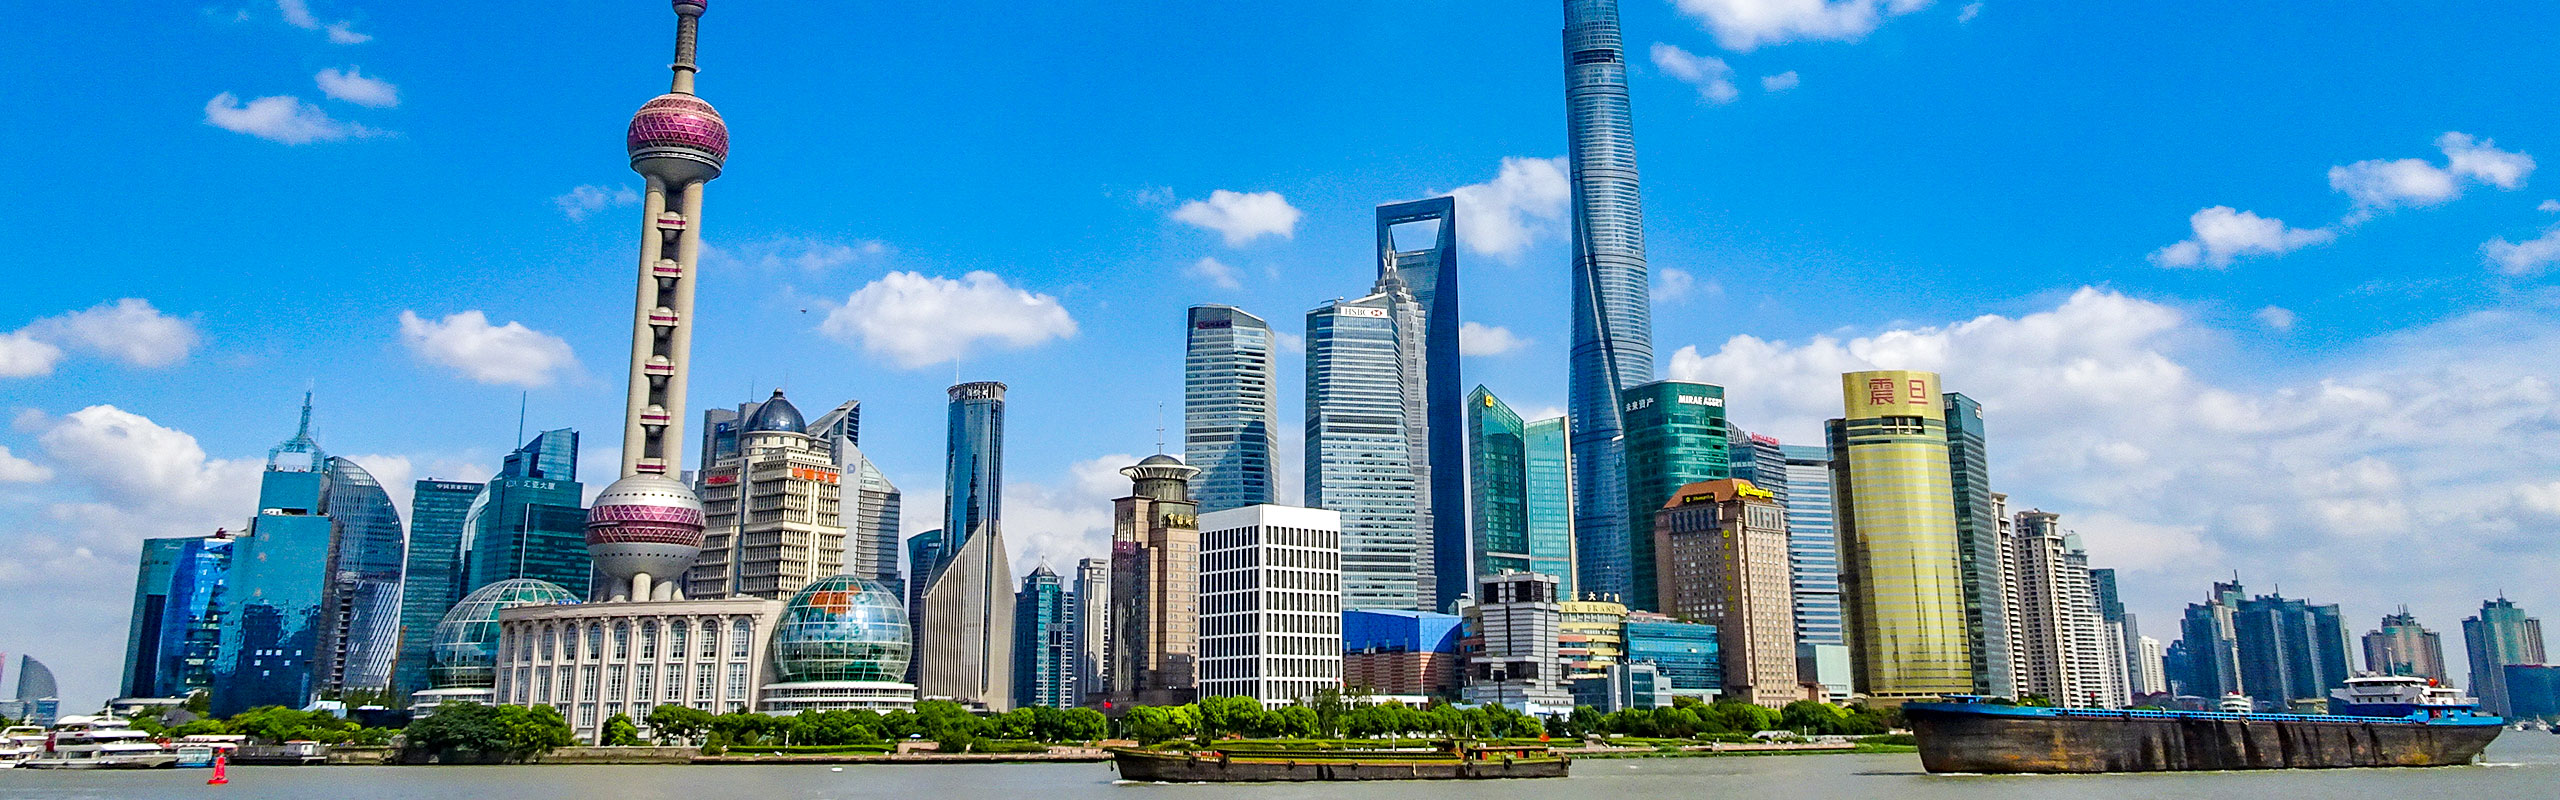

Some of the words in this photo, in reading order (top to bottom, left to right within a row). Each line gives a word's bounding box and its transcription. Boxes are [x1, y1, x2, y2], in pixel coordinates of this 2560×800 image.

[1344, 307, 1370, 317] HSBC
[1869, 378, 1928, 405] 震旦
[1678, 394, 1702, 405] MIRAE
[1703, 397, 1723, 407] ASSET
